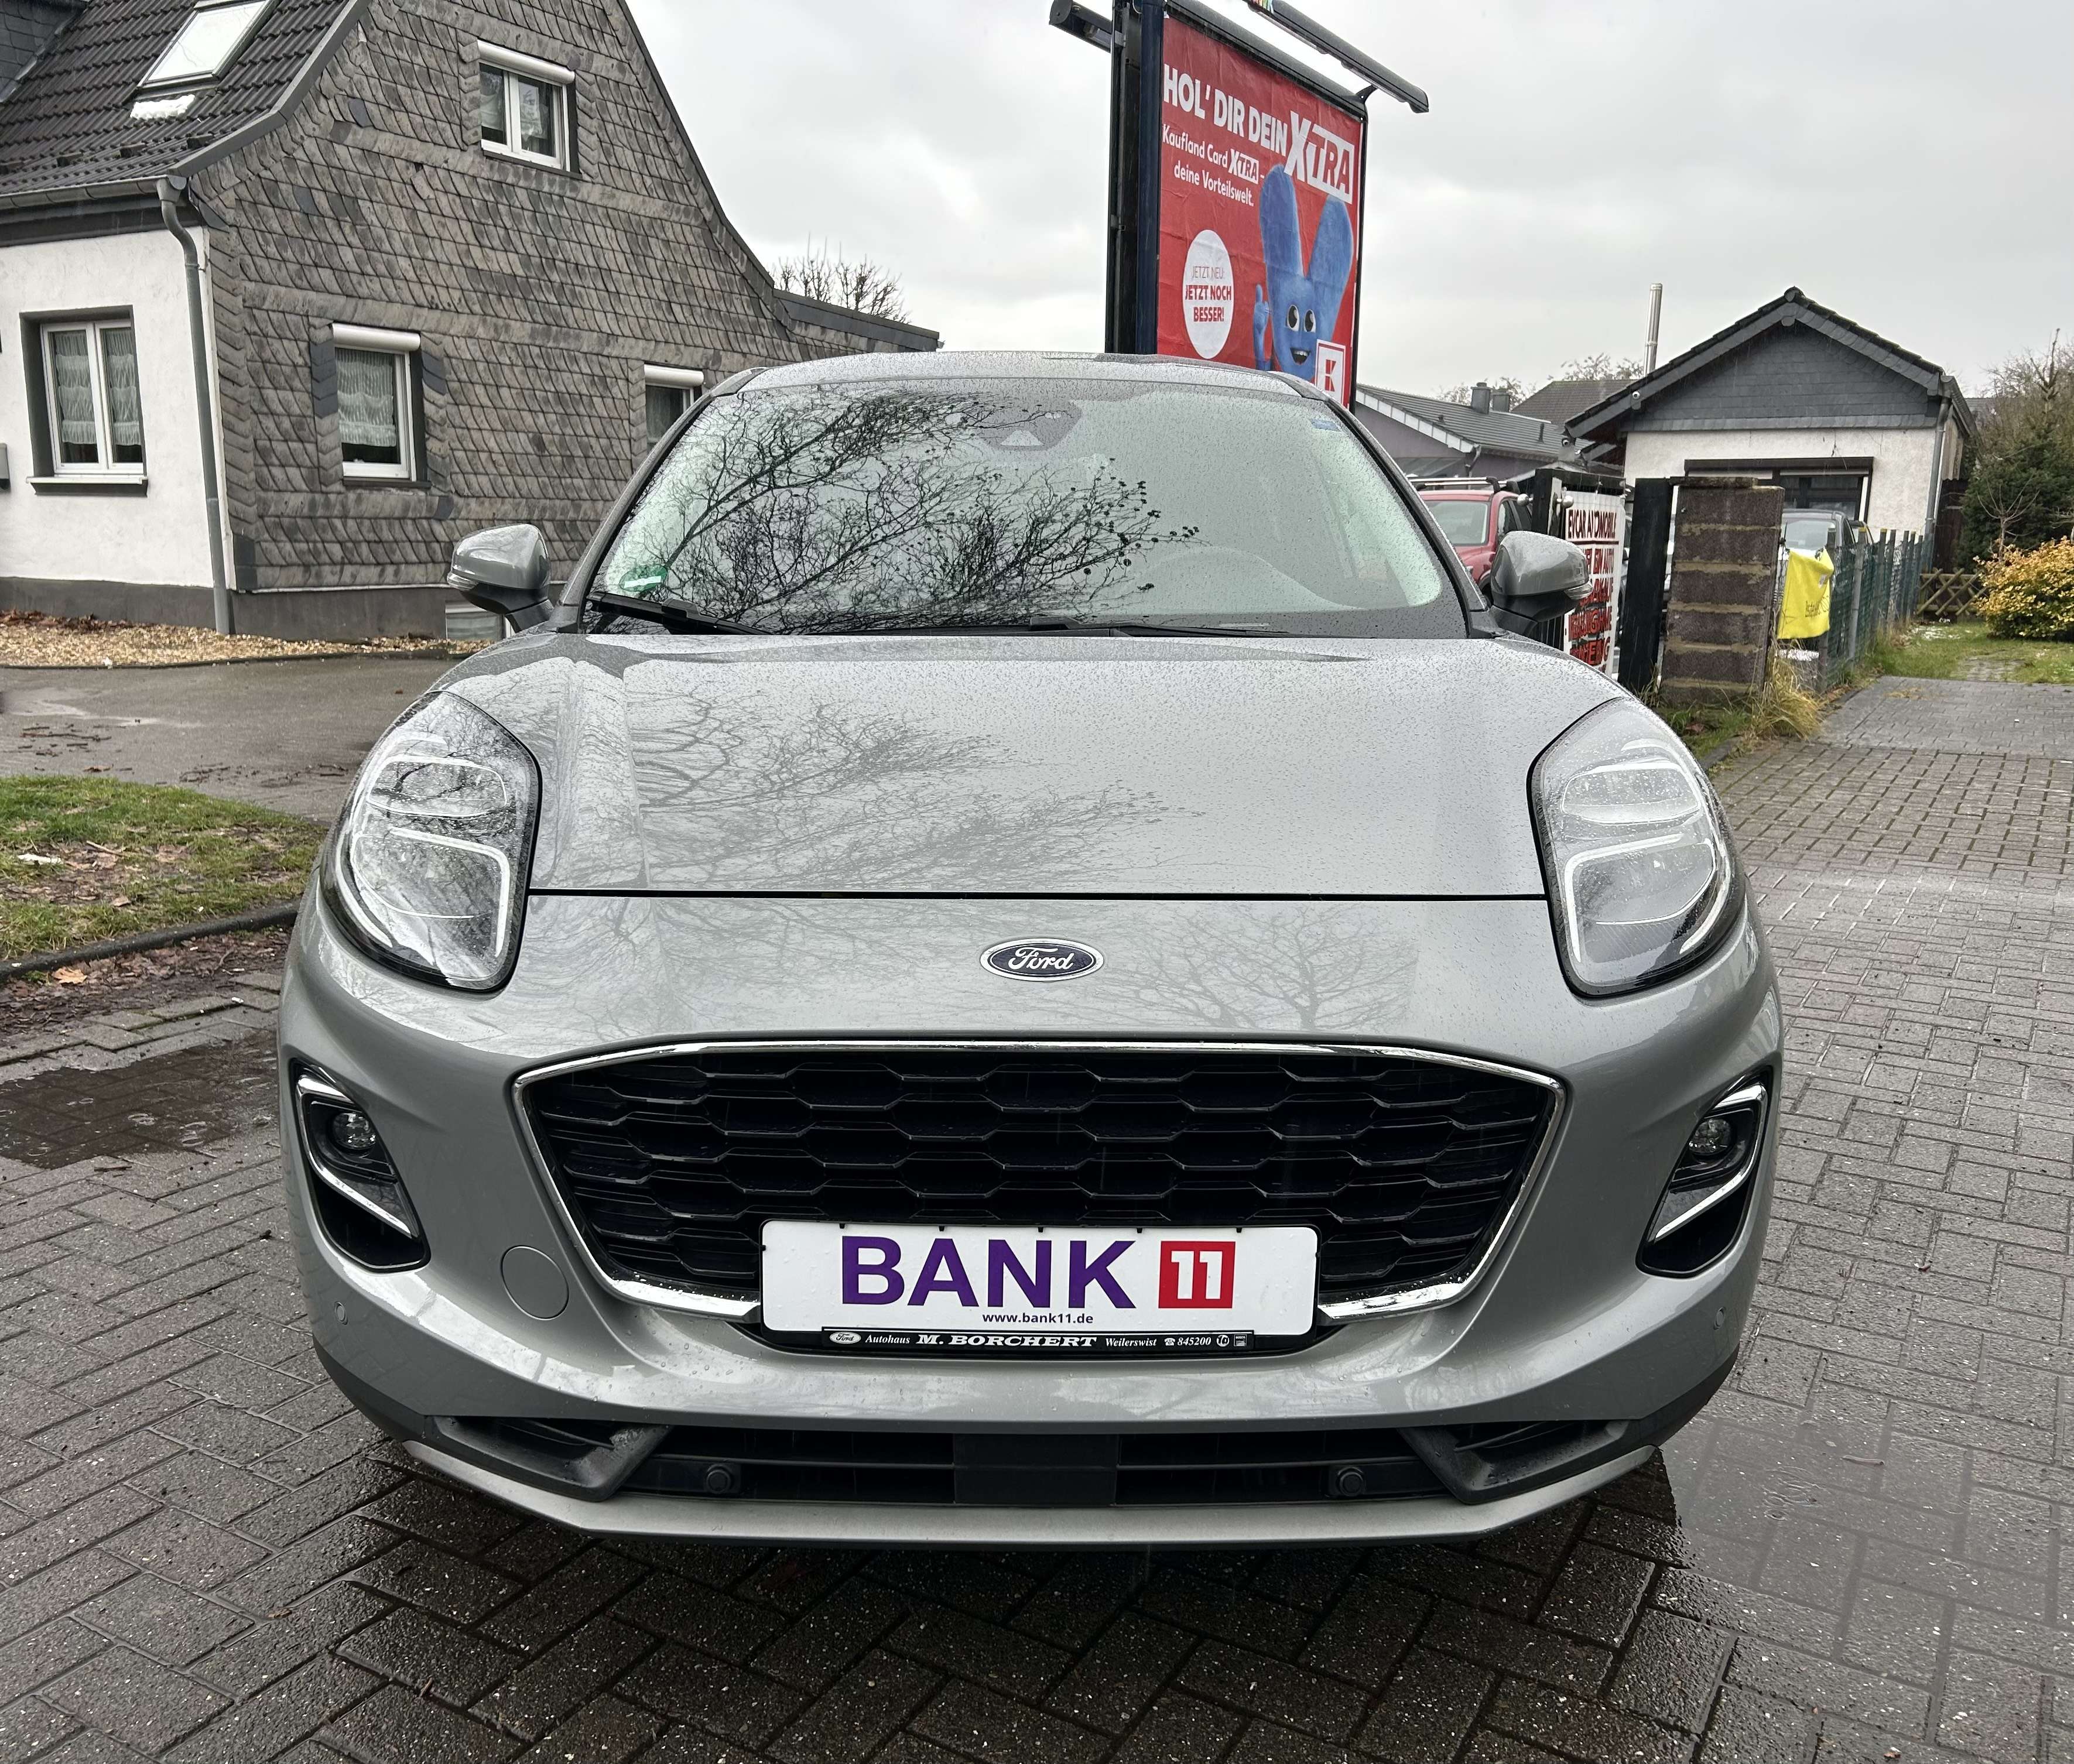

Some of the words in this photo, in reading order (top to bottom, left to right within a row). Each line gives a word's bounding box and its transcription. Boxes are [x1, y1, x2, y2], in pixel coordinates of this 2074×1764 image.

[1162, 124, 1205, 159] Kaufland
[1207, 143, 1228, 169] Card
[1228, 148, 1259, 185] XTRA
[1213, 88, 1244, 138] DIR
[1248, 105, 1288, 157] DEIN
[1284, 110, 1355, 204] XTRA
[1174, 160, 1200, 186] deine
[1202, 169, 1254, 207] Vorteilswelt.
[1192, 266, 1210, 279] JETZT
[1185, 285, 1209, 300] JETZT
[1210, 285, 1232, 301] NOCH
[1193, 306, 1224, 322] BESSER!
[1008, 946, 1074, 970] Ford
[842, 1235, 1136, 1309] BANK
[1171, 1251, 1223, 1300] 11
[982, 1312, 1094, 1324] www.bank11.de
[865, 1334, 911, 1344] Autohaus
[915, 1334, 944, 1345] M.
[947, 1335, 1097, 1347] BORCHERT
[1105, 1337, 1158, 1347] Weilerswist
[1176, 1337, 1212, 1346] 845200
